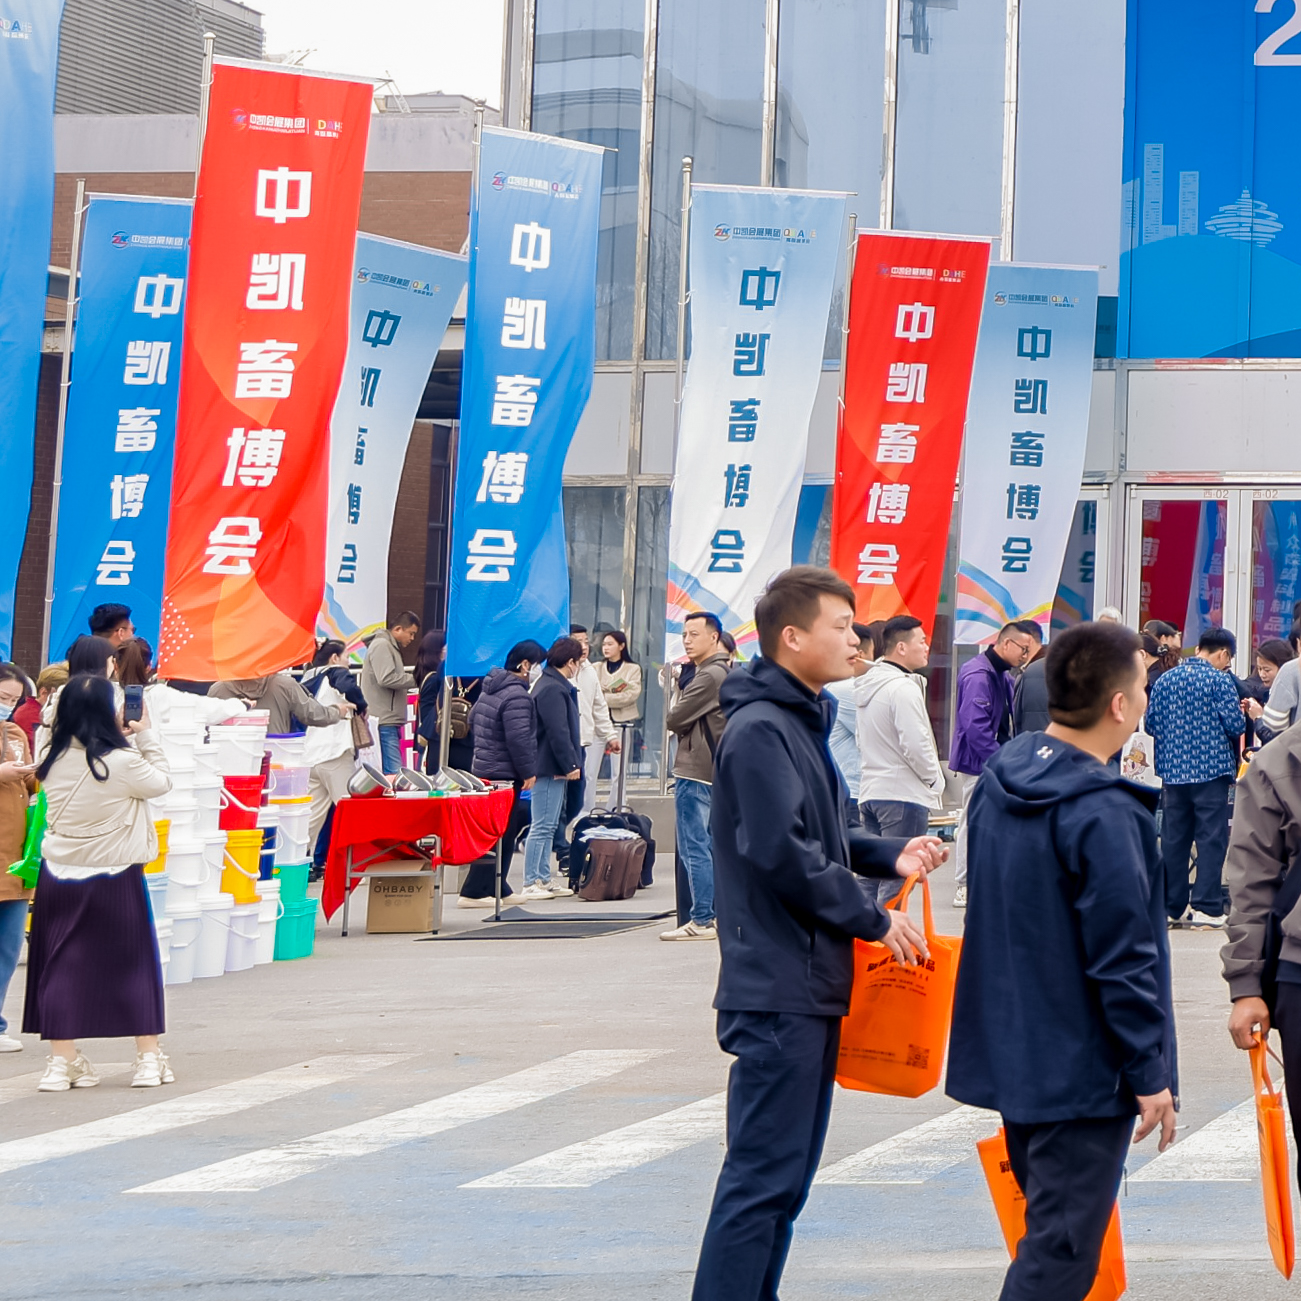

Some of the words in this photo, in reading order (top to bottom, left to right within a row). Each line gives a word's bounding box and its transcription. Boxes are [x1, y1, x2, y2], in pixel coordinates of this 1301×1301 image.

[97, 274, 185, 587] 中凯畜博会
[203, 166, 313, 577] 中凯畜博会
[465, 221, 551, 582] 中凯畜博会
[707, 265, 782, 574] 中凯畜博会
[857, 301, 935, 586] 中凯畜博会
[1001, 325, 1053, 574] 中凯畜博会
[373, 885, 423, 893] OHBABY
